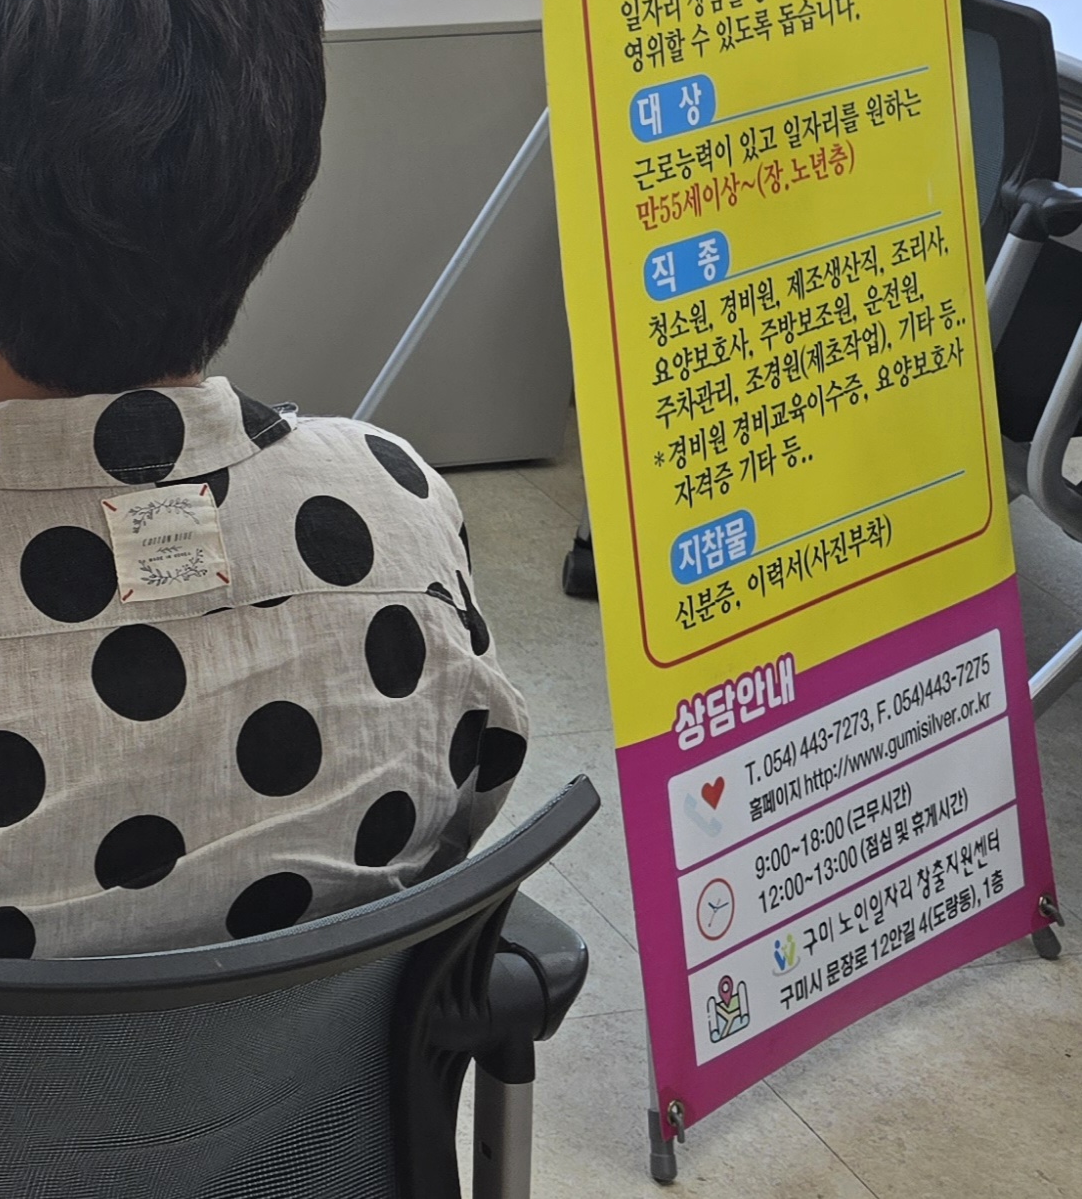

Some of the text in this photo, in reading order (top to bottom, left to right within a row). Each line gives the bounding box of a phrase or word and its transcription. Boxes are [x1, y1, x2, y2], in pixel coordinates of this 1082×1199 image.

[623, 27, 686, 73] 영위할
[689, 23, 711, 59] 수
[715, 7, 774, 54] 있도록
[632, 87, 922, 192] 근로능력이 있고 일자리를 원하는
[898, 305, 935, 343] 기타
[874, 336, 965, 394] 요양보호사
[674, 459, 734, 509] 자격증
[738, 443, 777, 484] 기타
[677, 517, 748, 576] 지참물
[747, 513, 894, 598] 이력서(사진부착)
[674, 656, 796, 752] 상담안내
[748, 778, 803, 823] 홈페이지
[754, 780, 913, 880] 9:00~18:00 (근무시간)
[758, 786, 970, 914] 12:00~13:00 (점심 및 휴게시간)
[779, 971, 824, 1011] 구미시
[826, 944, 868, 988] 문장로
[870, 916, 917, 963] 12안길
[982, 868, 1006, 899] 1층
